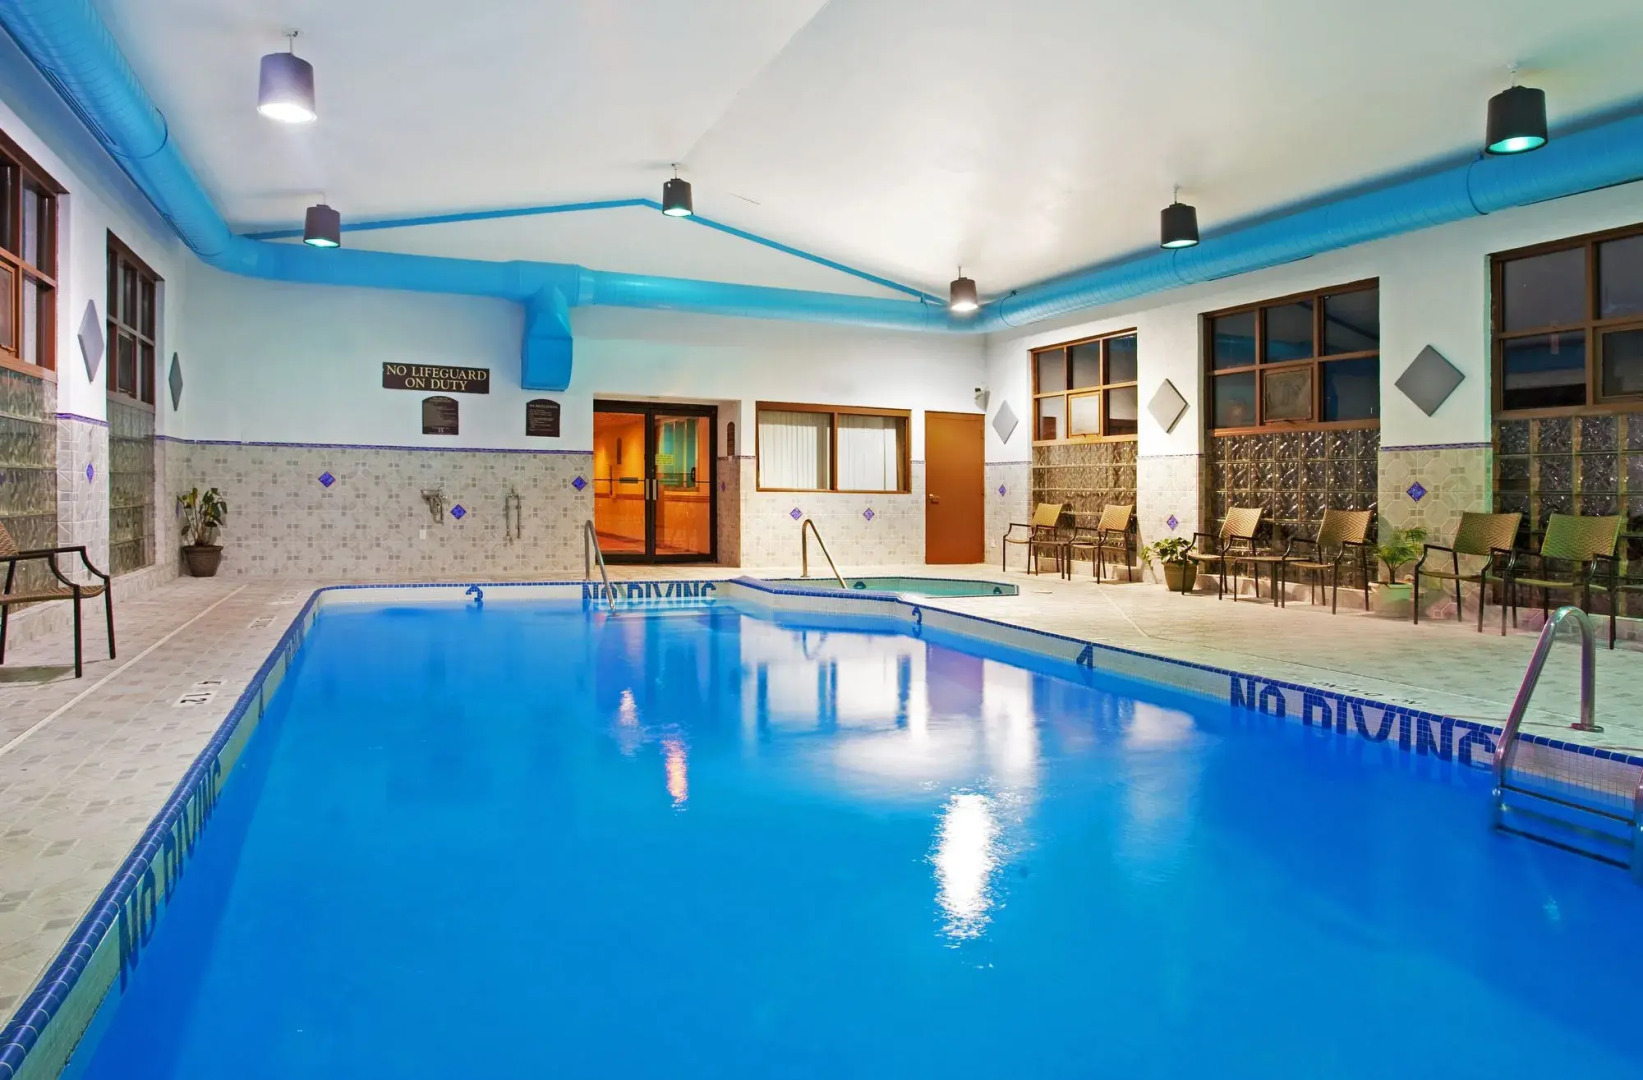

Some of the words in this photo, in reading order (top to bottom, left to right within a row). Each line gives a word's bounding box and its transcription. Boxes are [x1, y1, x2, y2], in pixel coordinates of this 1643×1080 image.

[386, 364, 407, 376] NO
[411, 366, 487, 380] LIFEGUARD
[405, 377, 425, 389] ON
[430, 379, 468, 391] DUTY
[1230, 676, 1286, 718] NO
[1302, 692, 1498, 772] DIVING
